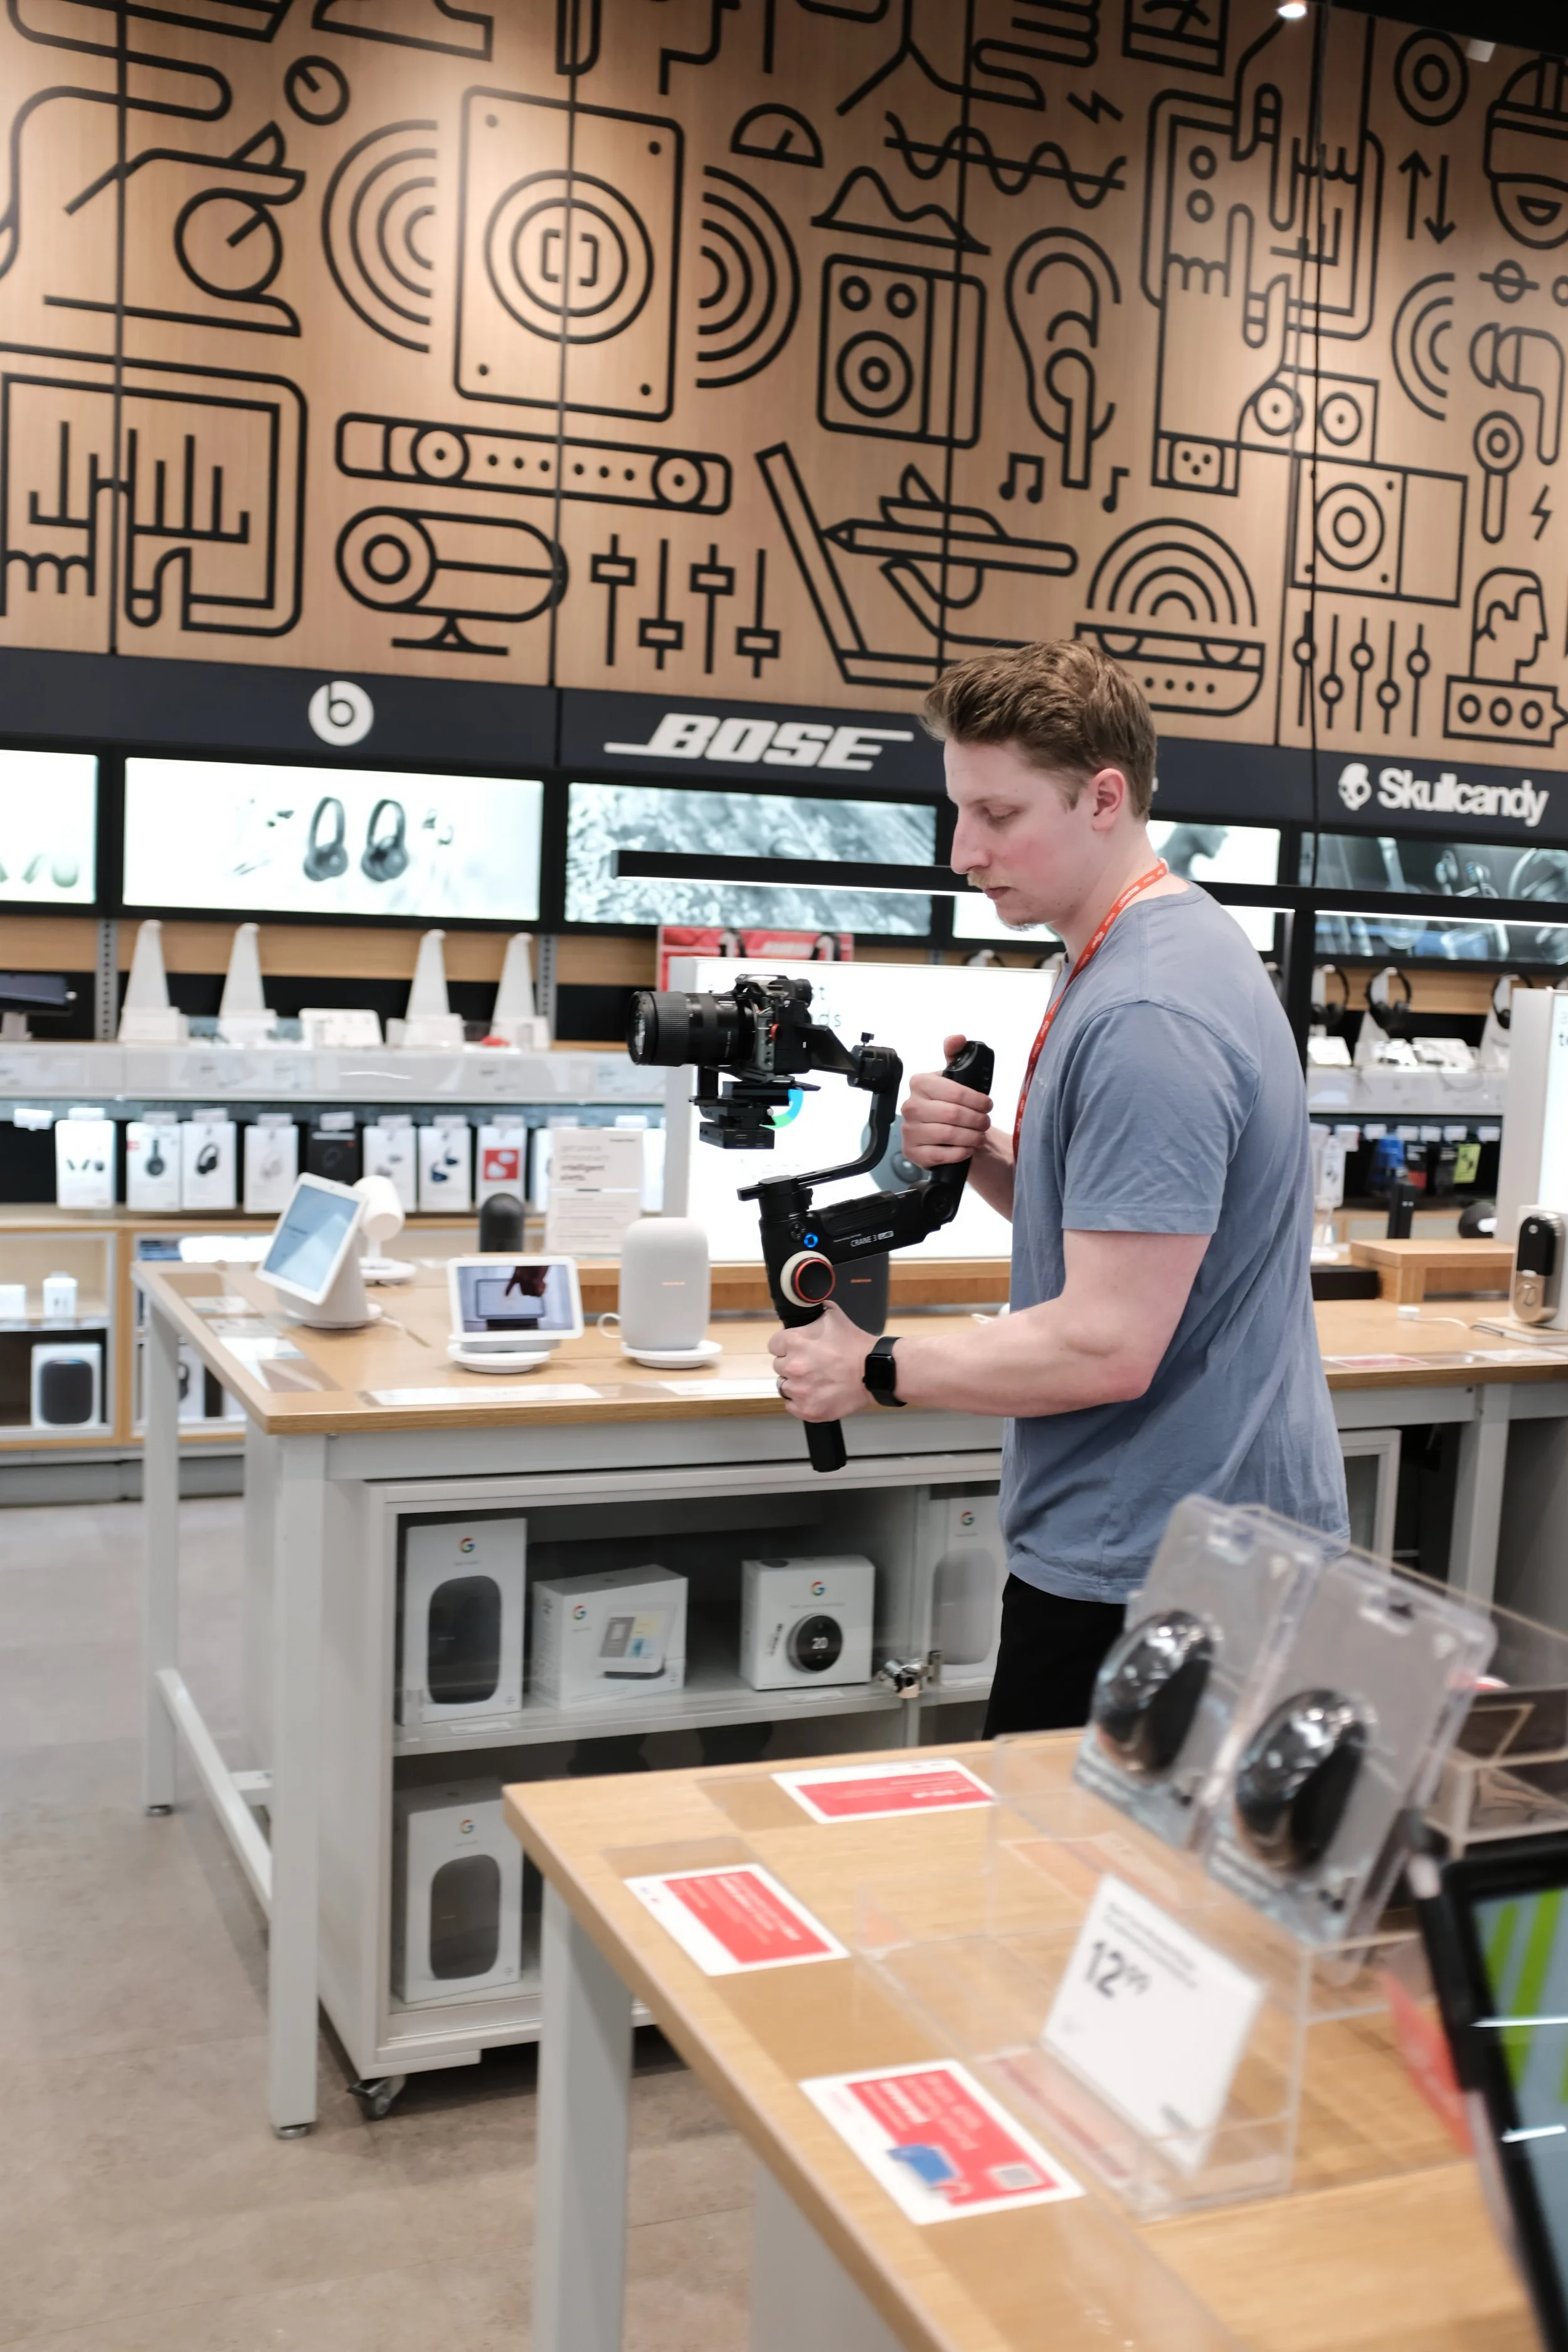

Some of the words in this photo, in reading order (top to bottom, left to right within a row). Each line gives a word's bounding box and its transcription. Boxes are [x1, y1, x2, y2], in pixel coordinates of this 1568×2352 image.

[603, 712, 914, 771] BOSE
[1377, 767, 1549, 827] Skullcandy
[850, 1236, 872, 1247] CRANE
[459, 1537, 476, 1554] G
[810, 1581, 826, 1596] G
[812, 1637, 829, 1650] 20
